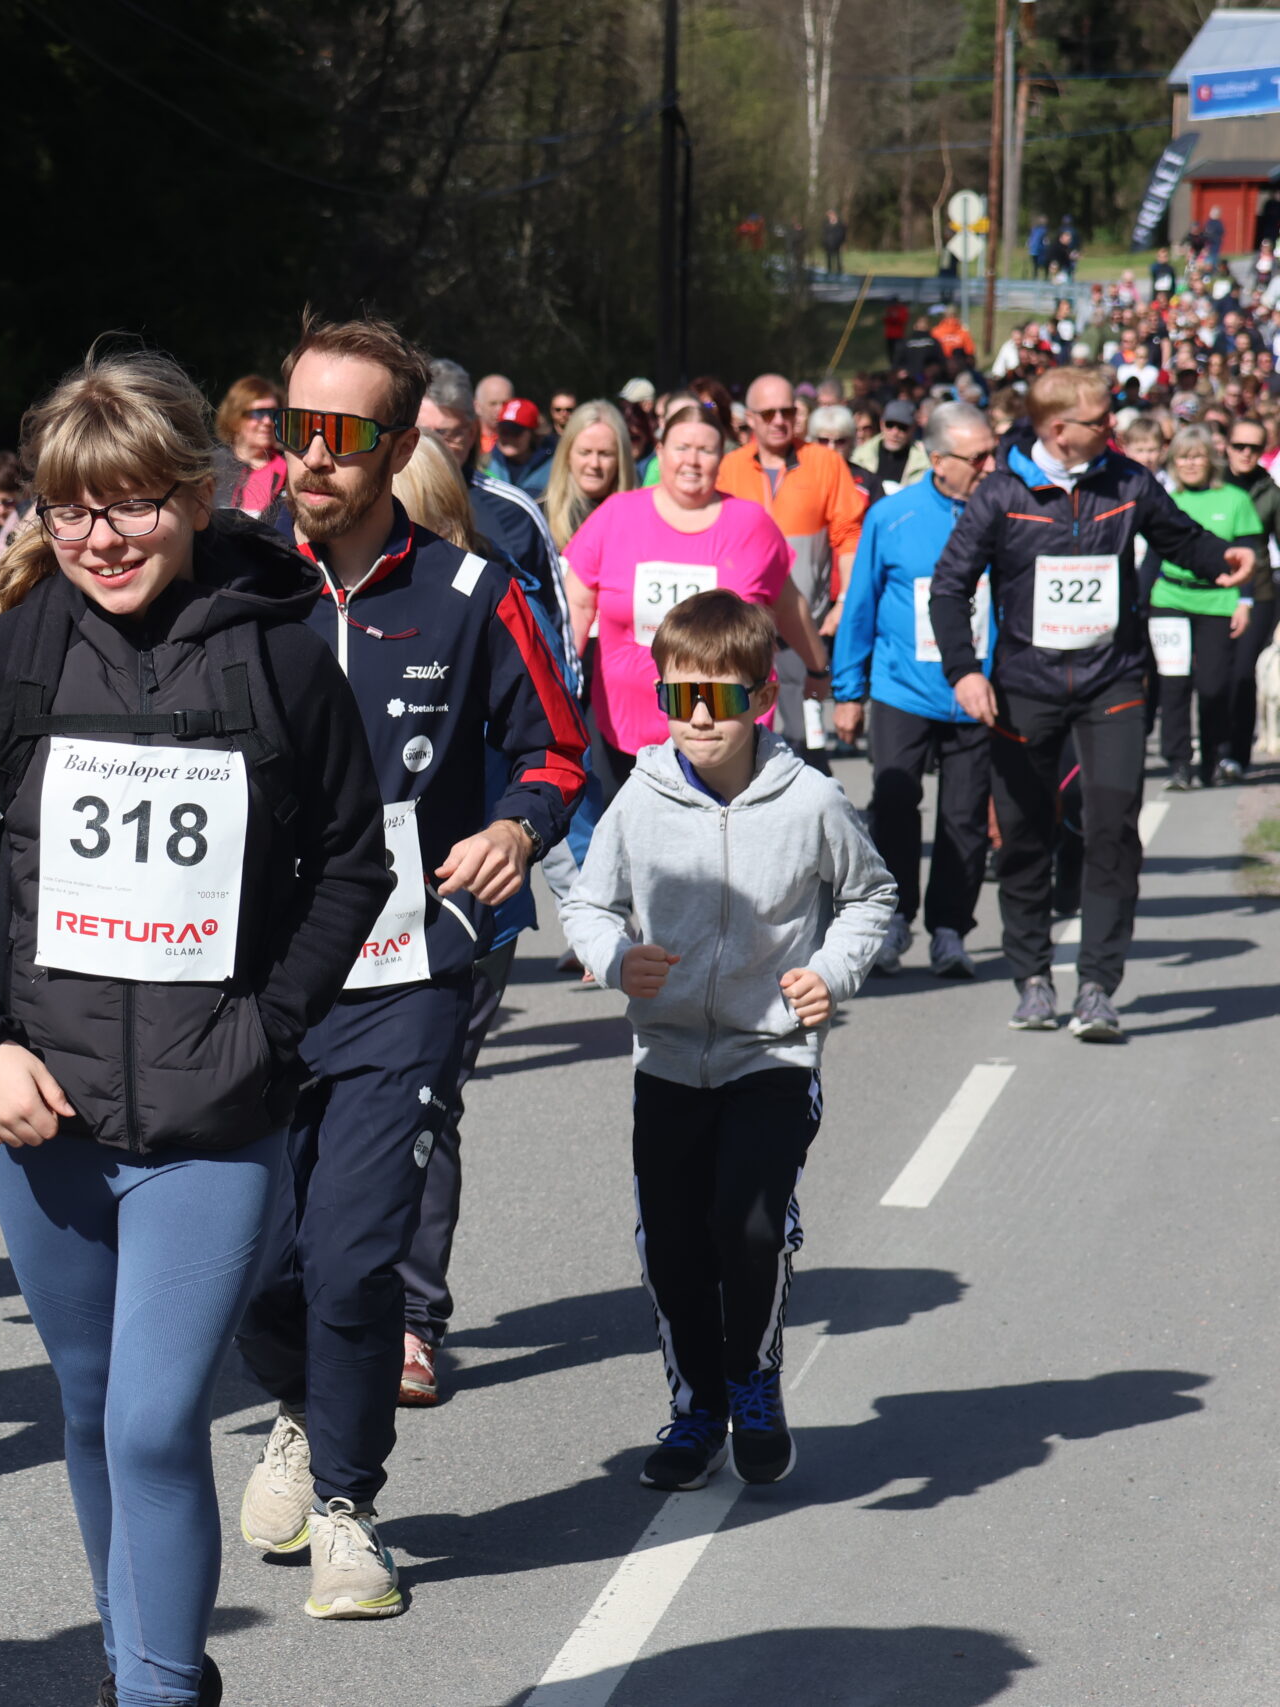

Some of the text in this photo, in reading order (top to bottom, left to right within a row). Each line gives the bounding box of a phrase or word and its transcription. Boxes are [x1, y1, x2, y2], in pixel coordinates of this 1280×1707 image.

[1048, 579, 1102, 603] 322
[63, 754, 231, 783] Baksjøløpet 2025
[69, 795, 208, 867] 318
[383, 814, 406, 830] 025
[56, 910, 202, 944] RETURA
